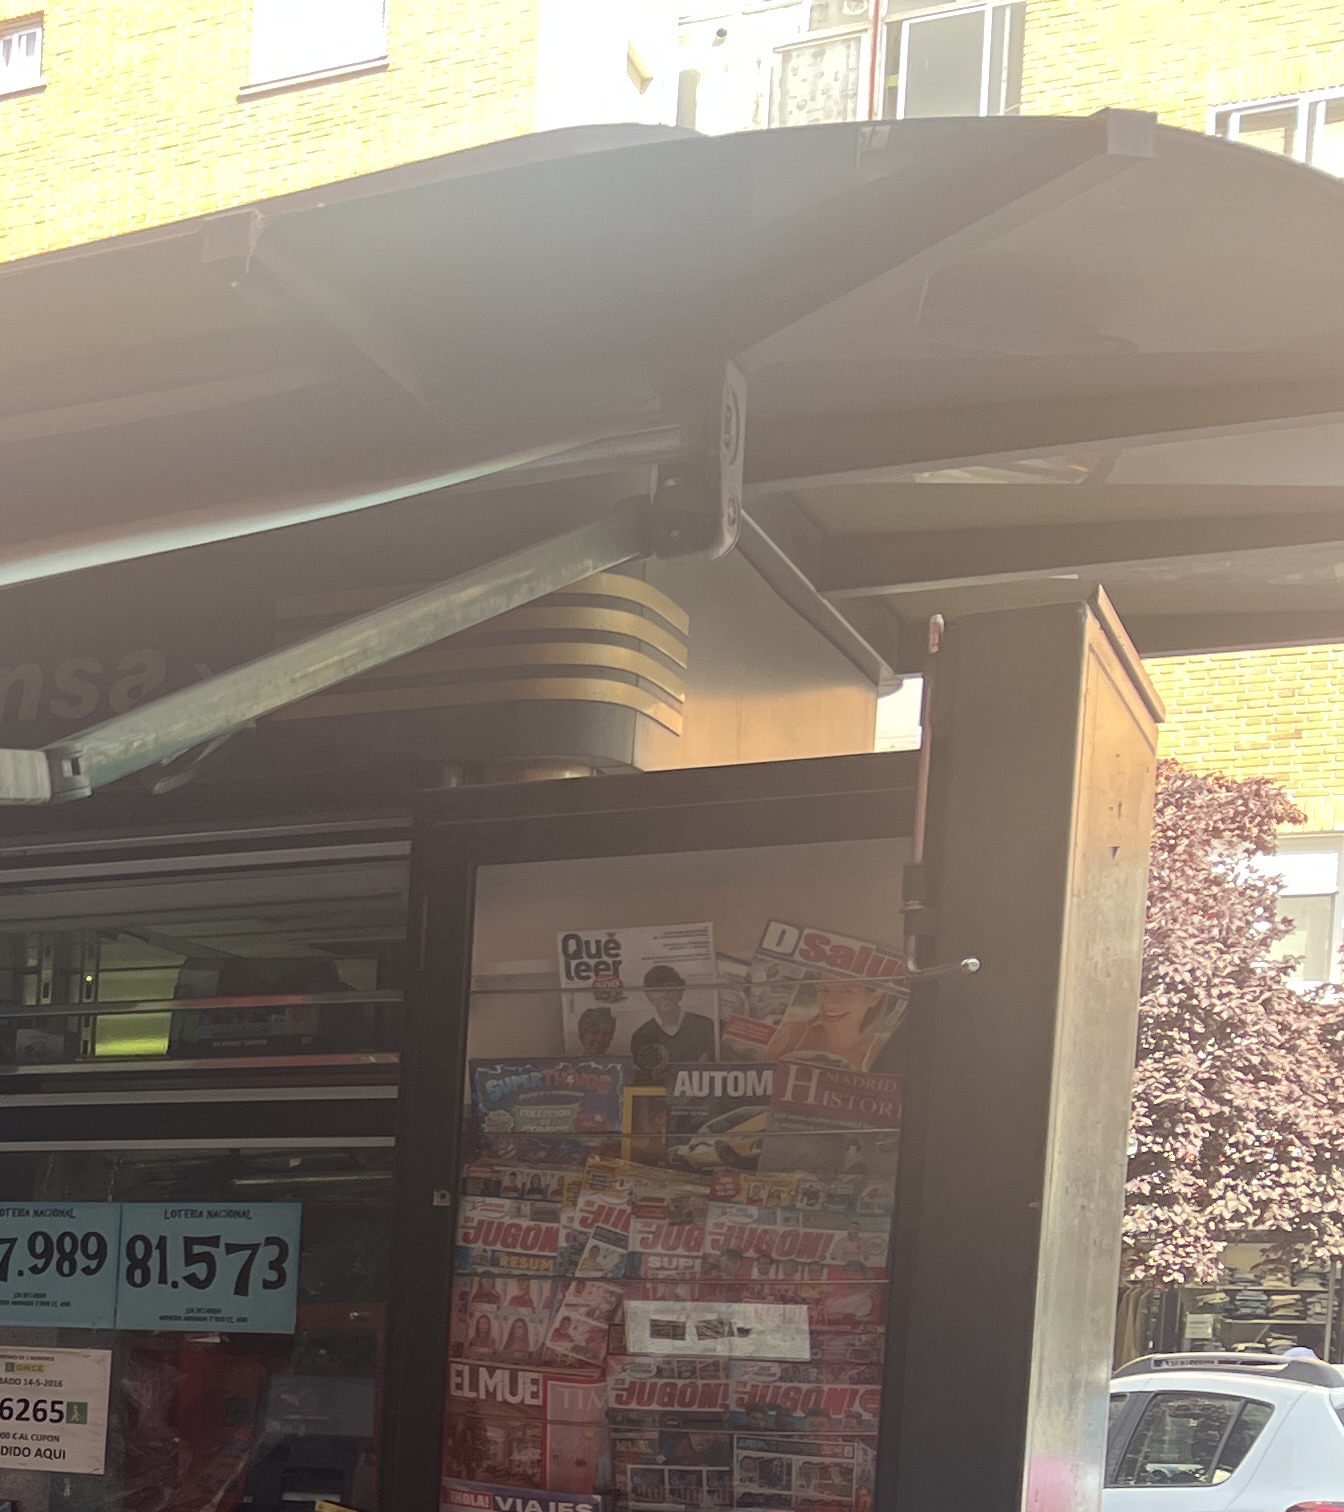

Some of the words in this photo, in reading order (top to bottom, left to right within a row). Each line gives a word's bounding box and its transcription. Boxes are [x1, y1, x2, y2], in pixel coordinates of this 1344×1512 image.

[673, 1069, 774, 1099] AUTOM
[825, 1070, 899, 1093] MADRID
[124, 1233, 290, 1298] 81.573
[33, 1447, 67, 1461] AQUI
